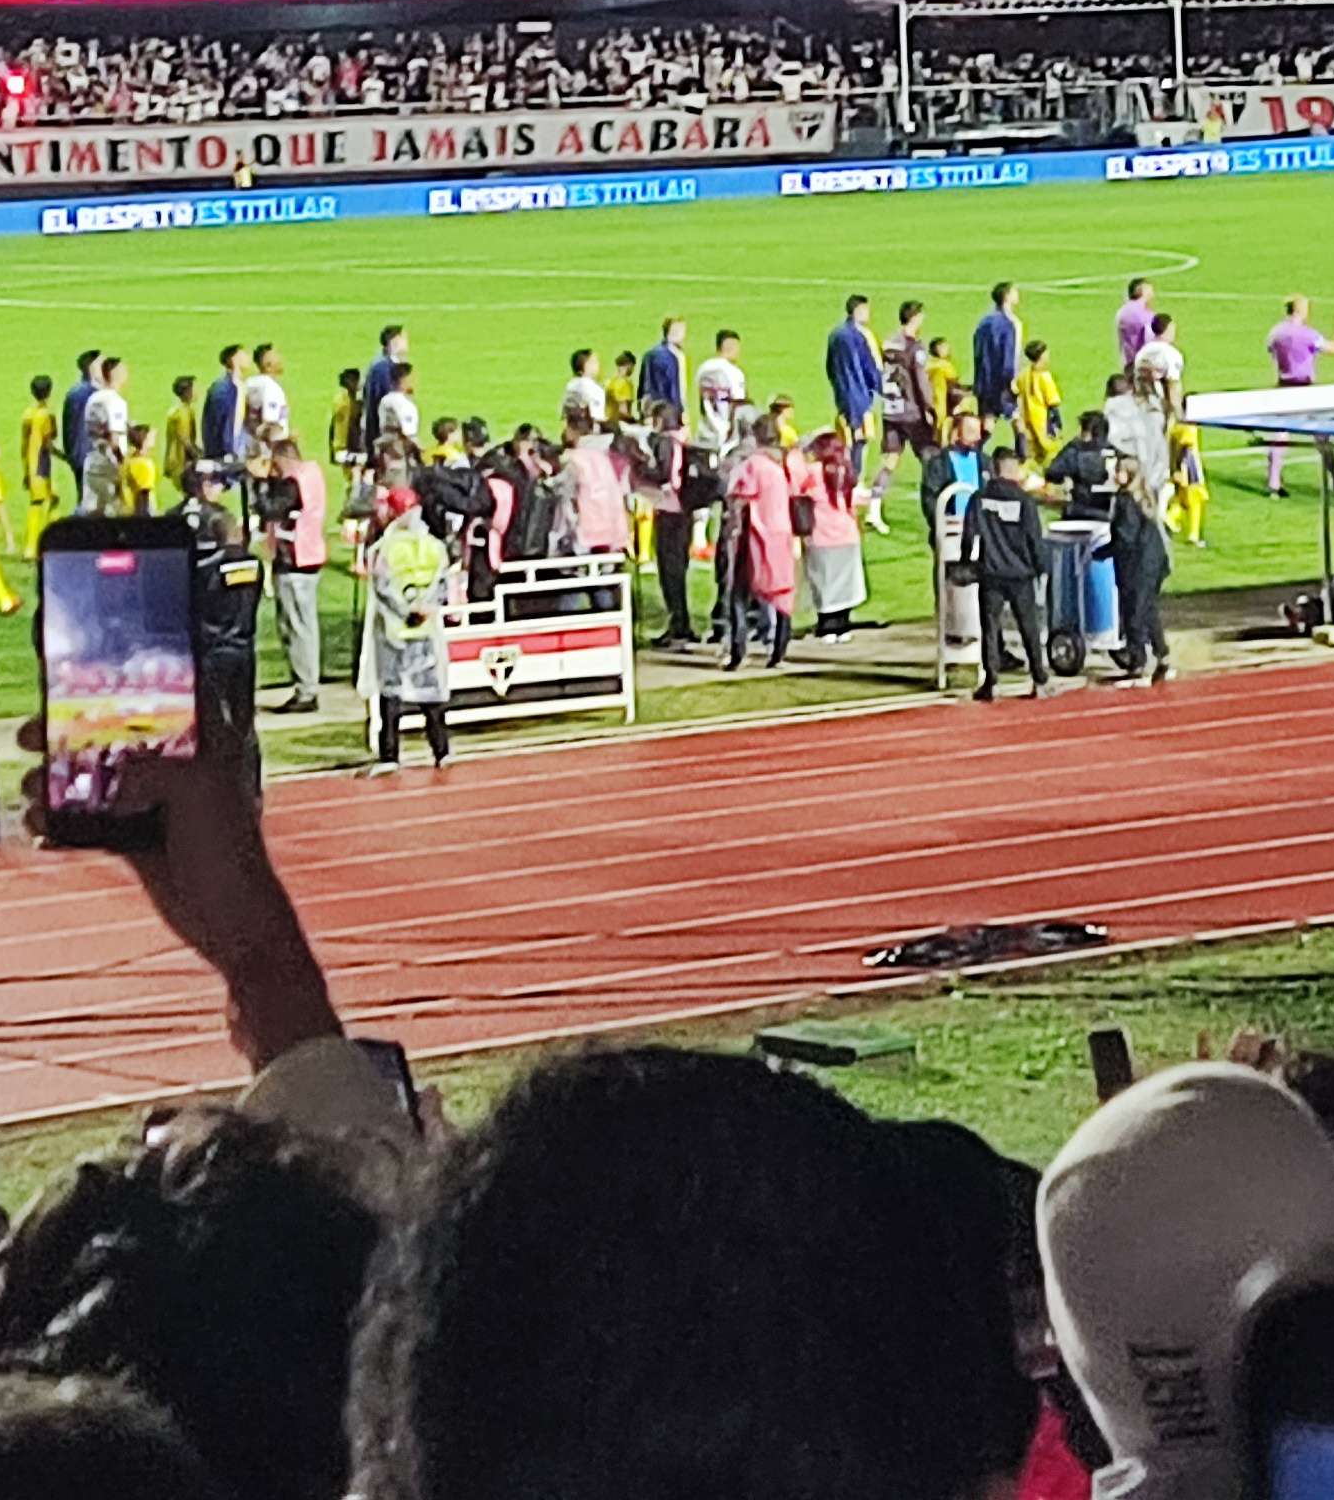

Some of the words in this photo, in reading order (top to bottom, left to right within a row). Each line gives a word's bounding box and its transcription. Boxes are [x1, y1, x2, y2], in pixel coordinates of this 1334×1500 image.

[254, 130, 347, 167] QUE
[372, 122, 536, 162] JAMAIS
[910, 167, 937, 188] ES
[940, 162, 1030, 186] TITULAR
[1232, 149, 1261, 172] ES
[569, 182, 598, 207] ES
[601, 178, 697, 203] TITULAR
[197, 199, 228, 226] ES
[230, 195, 337, 223] TITULAR
